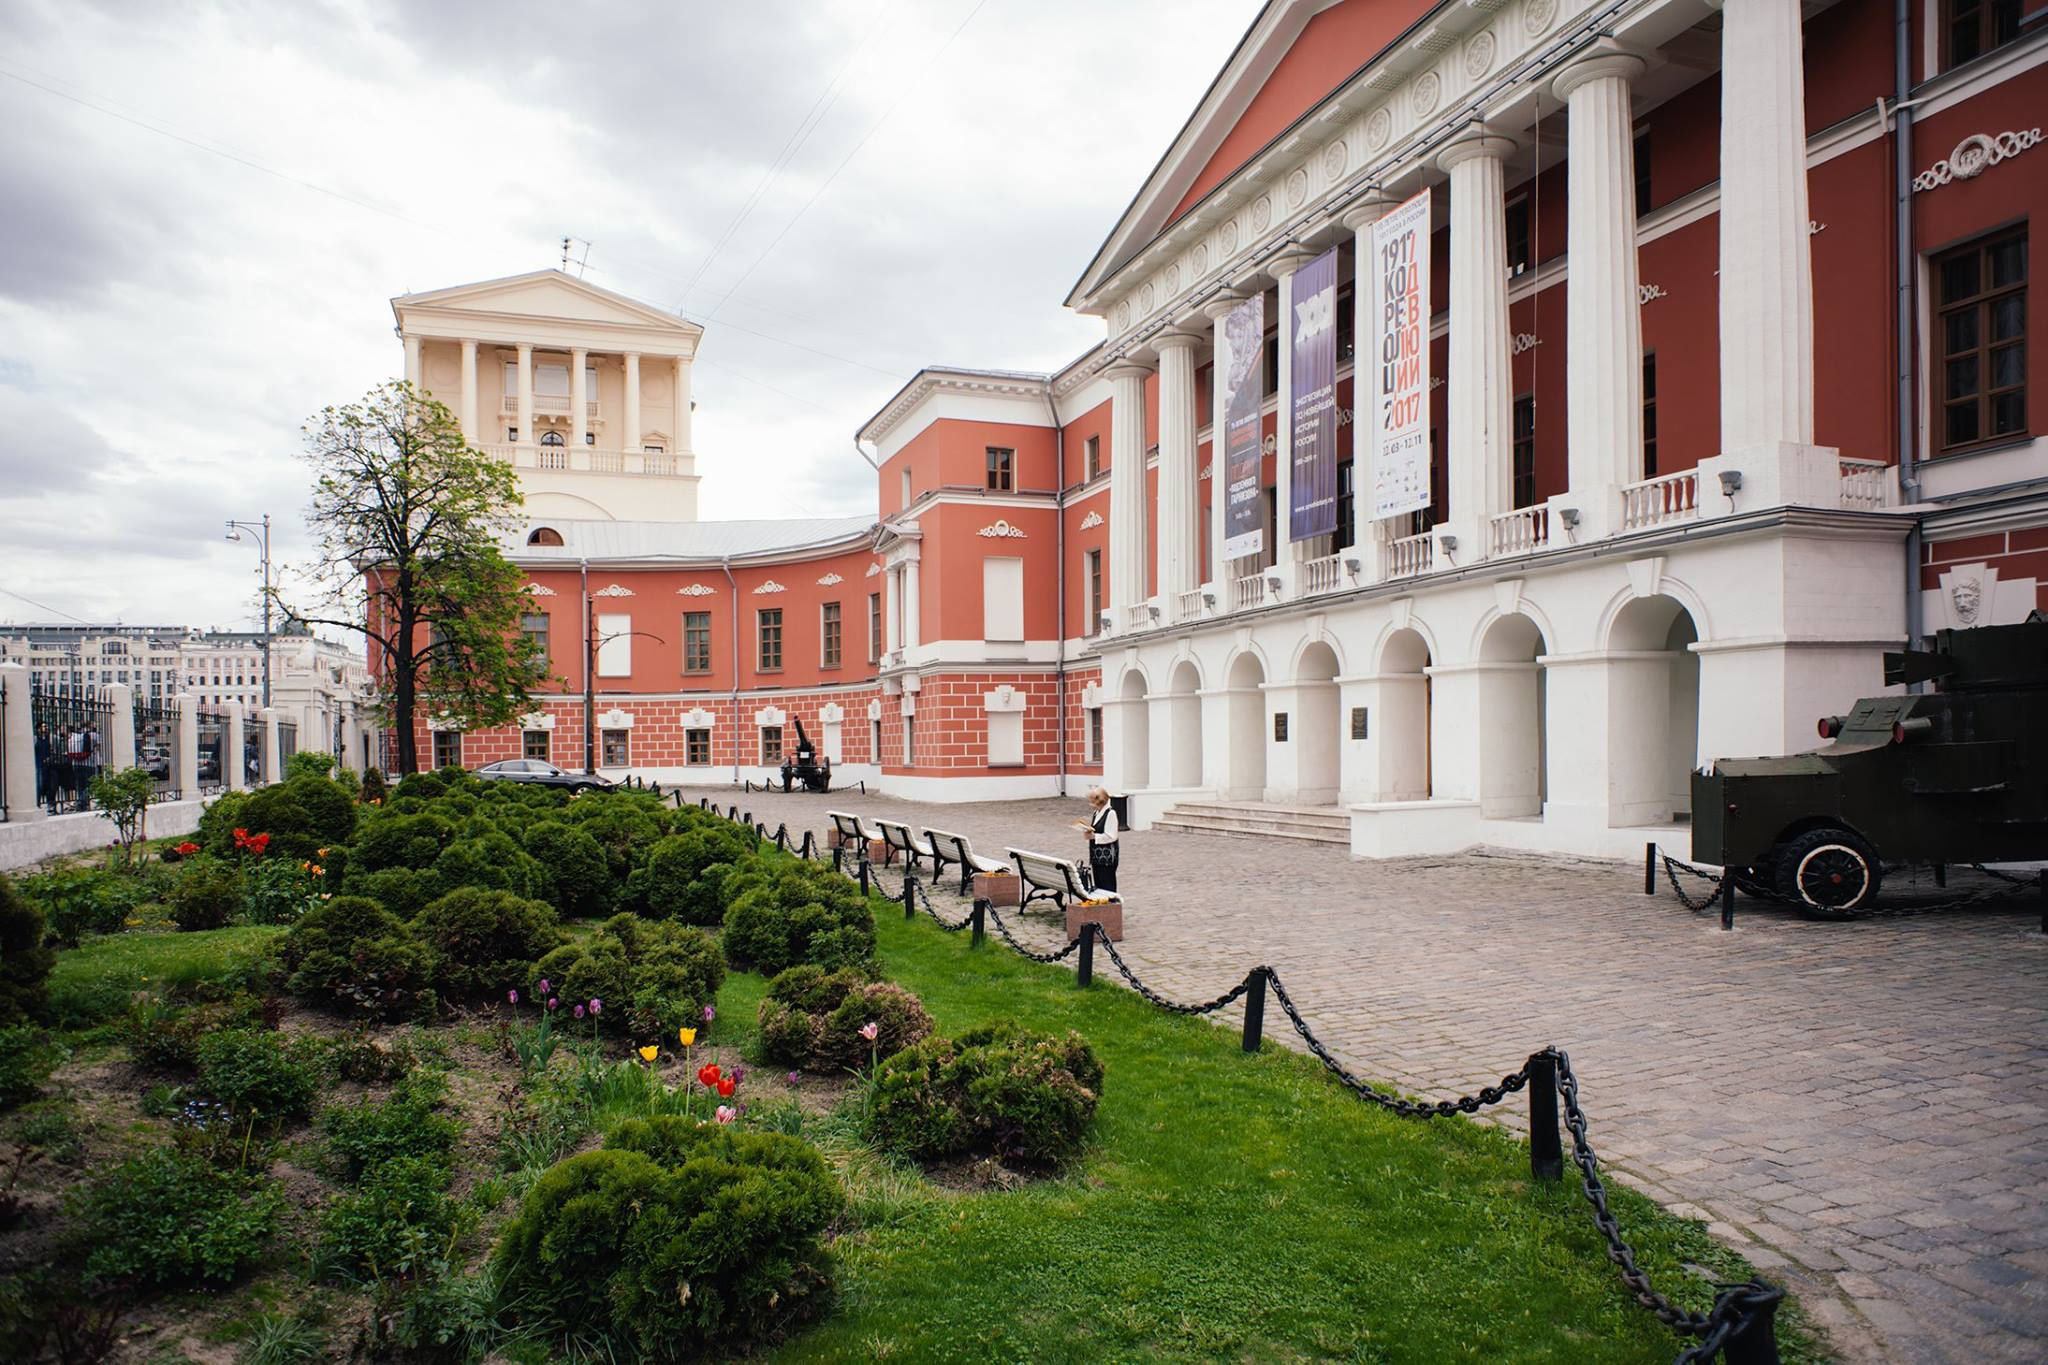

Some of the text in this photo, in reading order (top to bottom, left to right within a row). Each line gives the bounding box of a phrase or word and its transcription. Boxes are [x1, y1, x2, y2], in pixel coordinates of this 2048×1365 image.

[1381, 229, 1415, 274] 1917
[1384, 262, 1419, 304] КОД
[1385, 293, 1420, 334] РЕВ
[1383, 355, 1420, 397] ЦИИ
[1384, 392, 1420, 431] 2017
